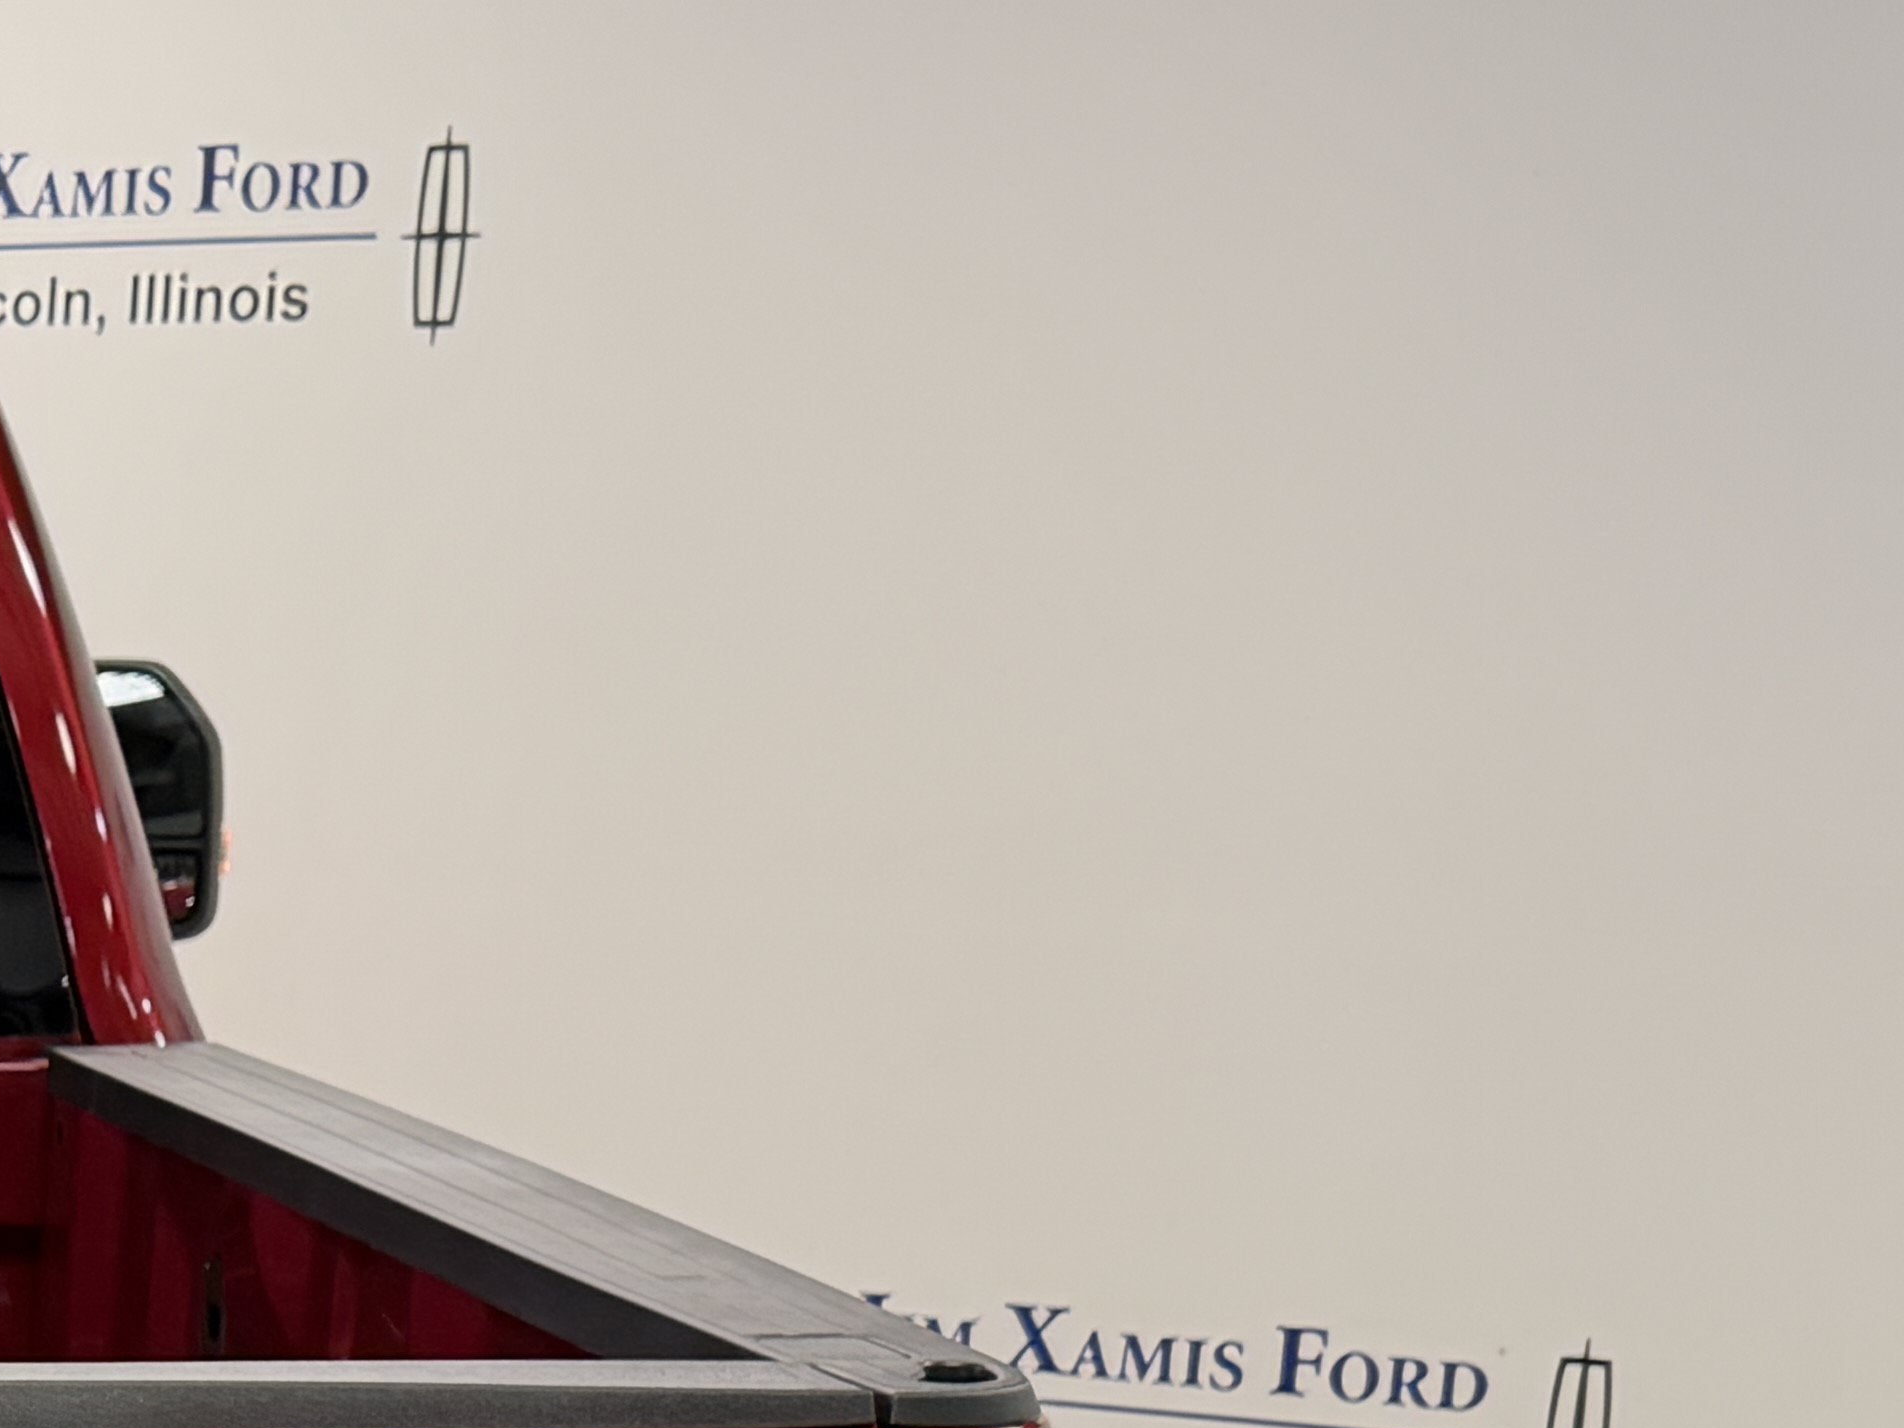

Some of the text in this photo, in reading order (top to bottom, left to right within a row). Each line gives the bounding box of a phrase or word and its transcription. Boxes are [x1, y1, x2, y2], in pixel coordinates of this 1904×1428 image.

[193, 143, 370, 214] FORD
[128, 270, 309, 326] Illinois
[1269, 1325, 1489, 1412] FORD
